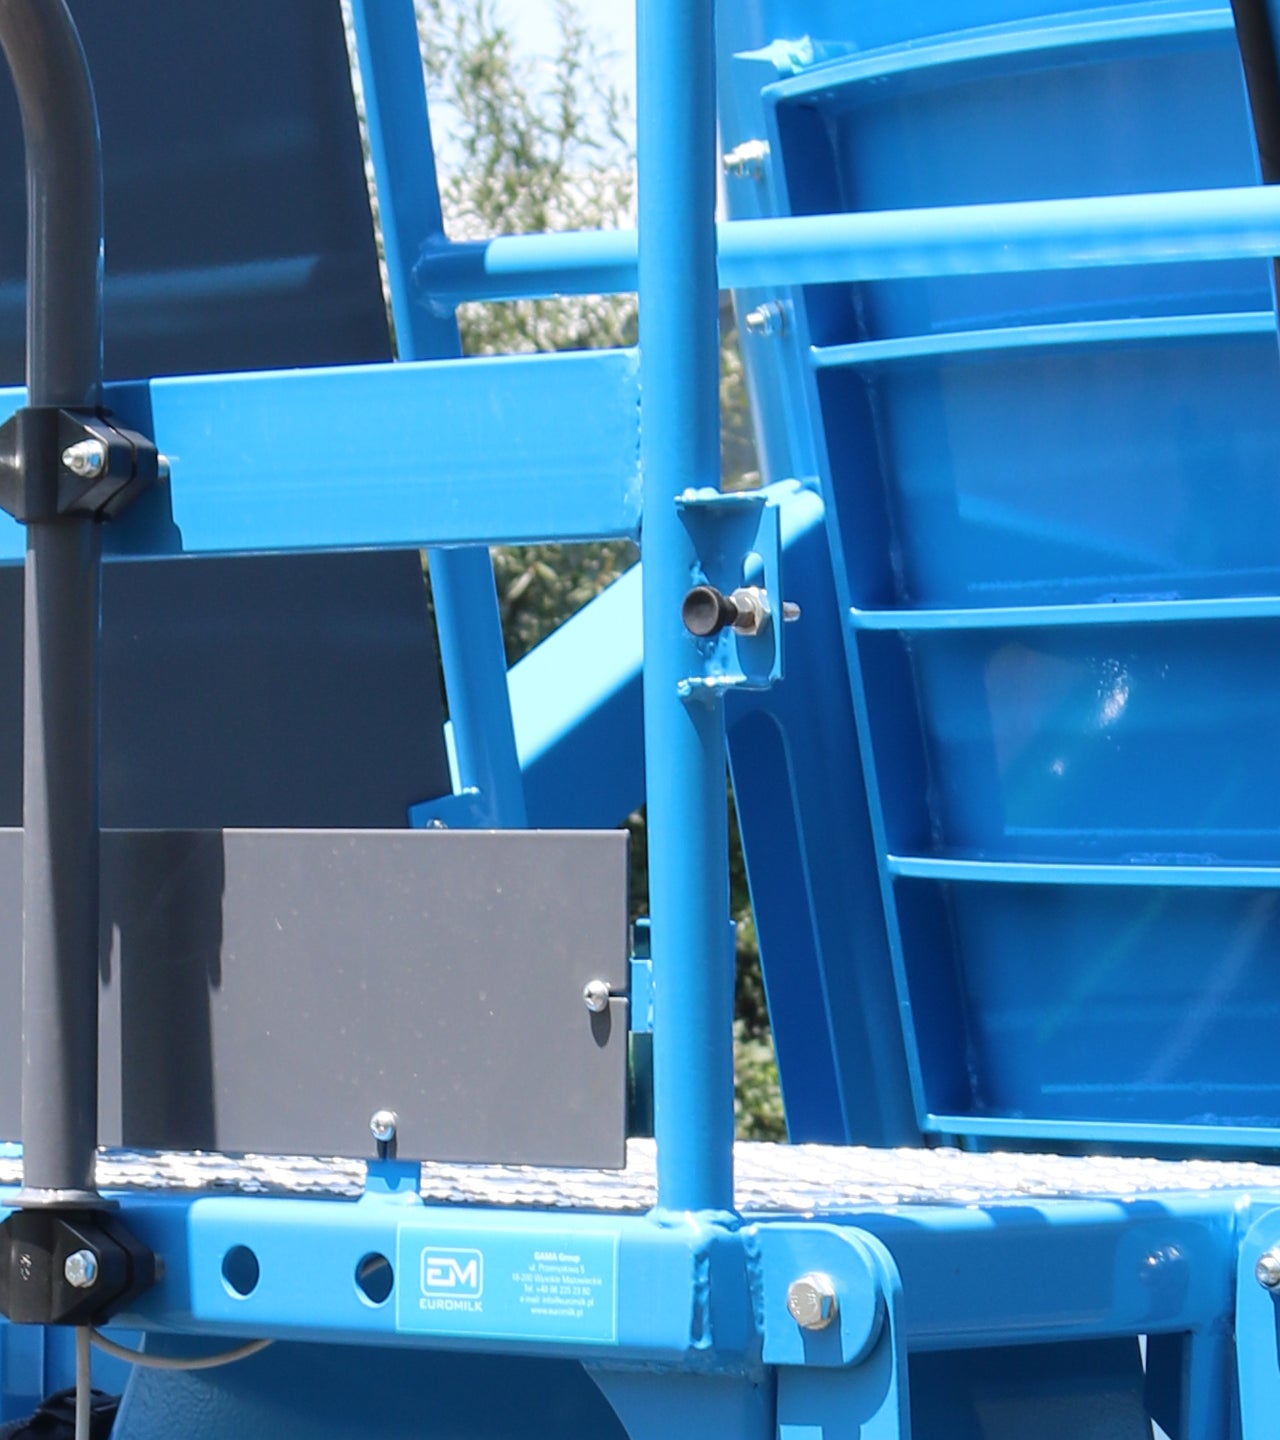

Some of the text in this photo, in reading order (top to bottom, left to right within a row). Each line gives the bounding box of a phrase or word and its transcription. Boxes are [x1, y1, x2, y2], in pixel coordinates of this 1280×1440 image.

[534, 1251, 581, 1263] GAMA Group
[427, 1257, 477, 1288] EM
[419, 1298, 483, 1312] EUROMILK
